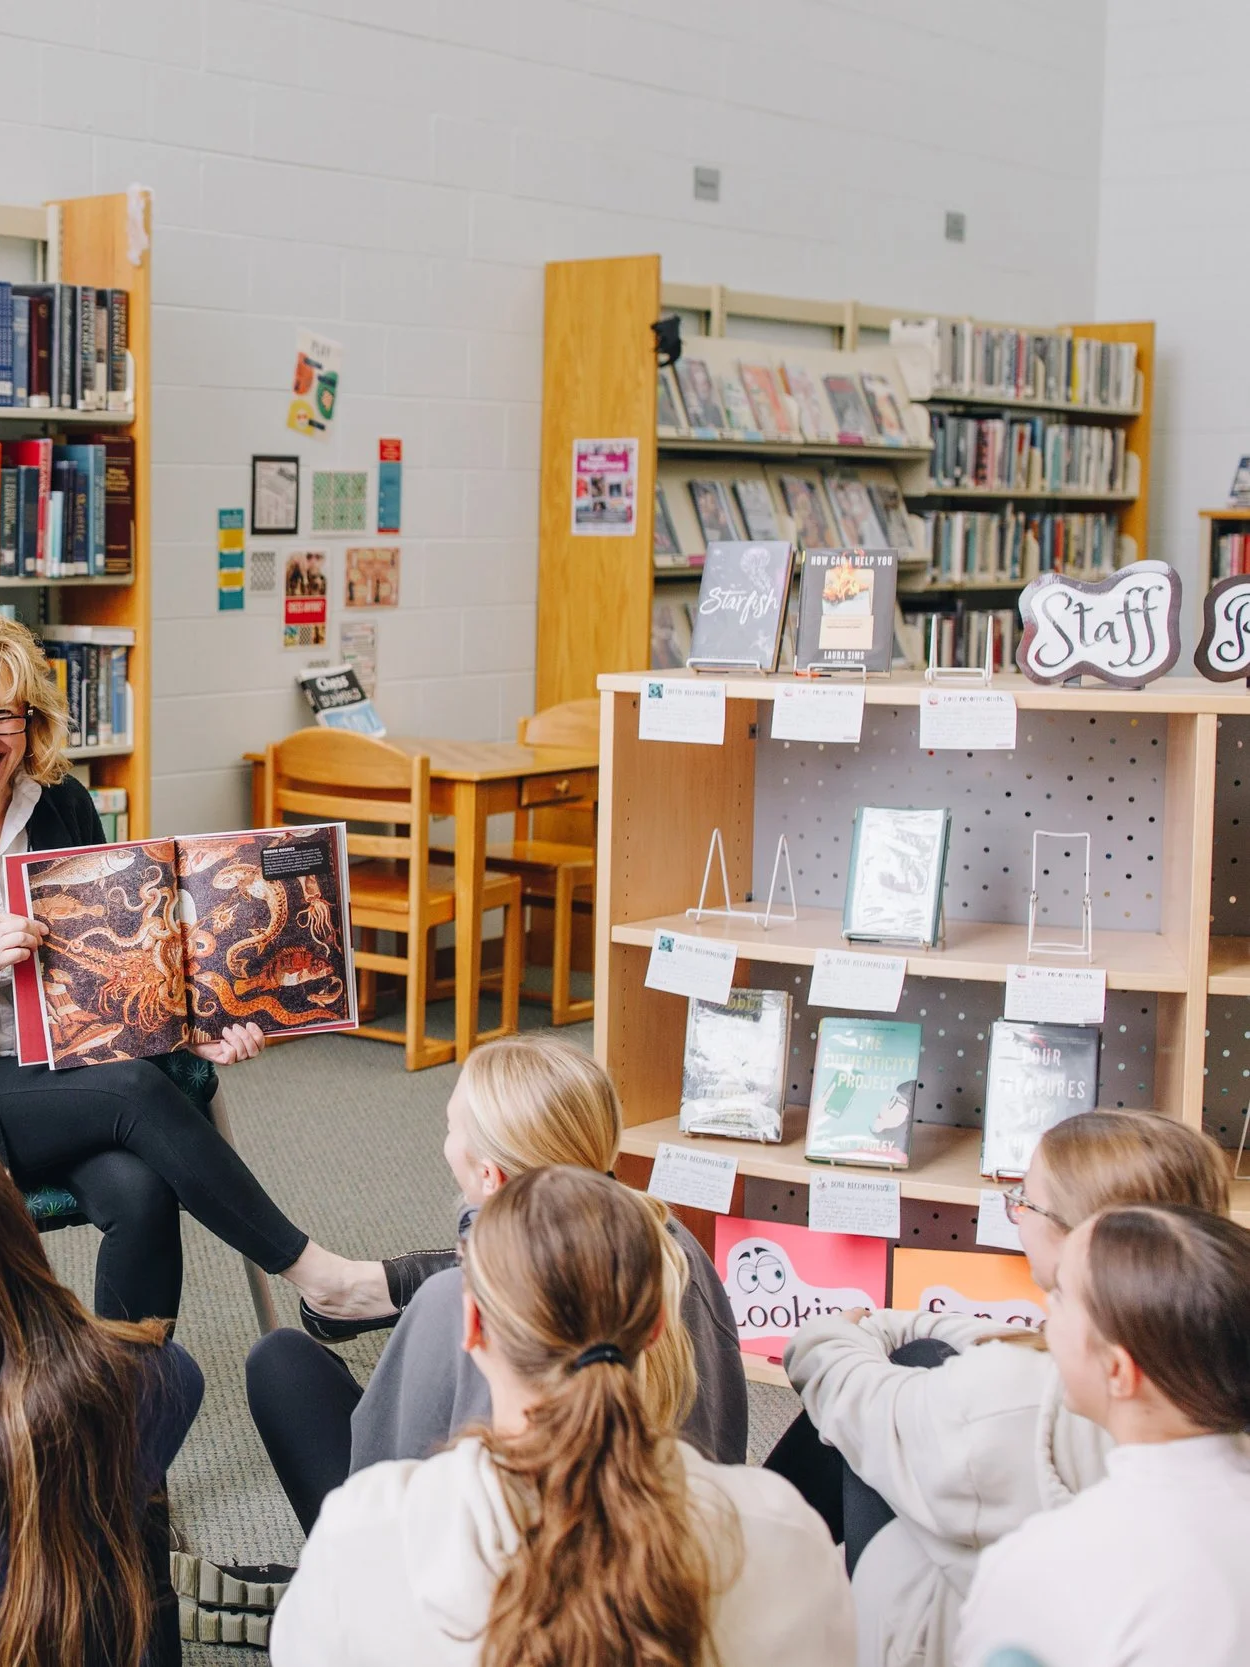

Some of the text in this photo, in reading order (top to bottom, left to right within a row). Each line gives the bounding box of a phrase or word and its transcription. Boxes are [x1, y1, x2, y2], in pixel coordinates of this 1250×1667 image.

[811, 555, 828, 566] HOW
[831, 556, 846, 566] CAN
[854, 555, 874, 567] HELP
[877, 555, 893, 567] YOU
[699, 586, 779, 624] Starfish
[1034, 584, 1164, 668] Staff
[824, 651, 865, 660] LAURA SIMS
[315, 674, 350, 692] Chess
[858, 1034, 884, 1051] THE
[837, 1072, 900, 1091] PROJECT
[730, 1294, 871, 1329] ookin
